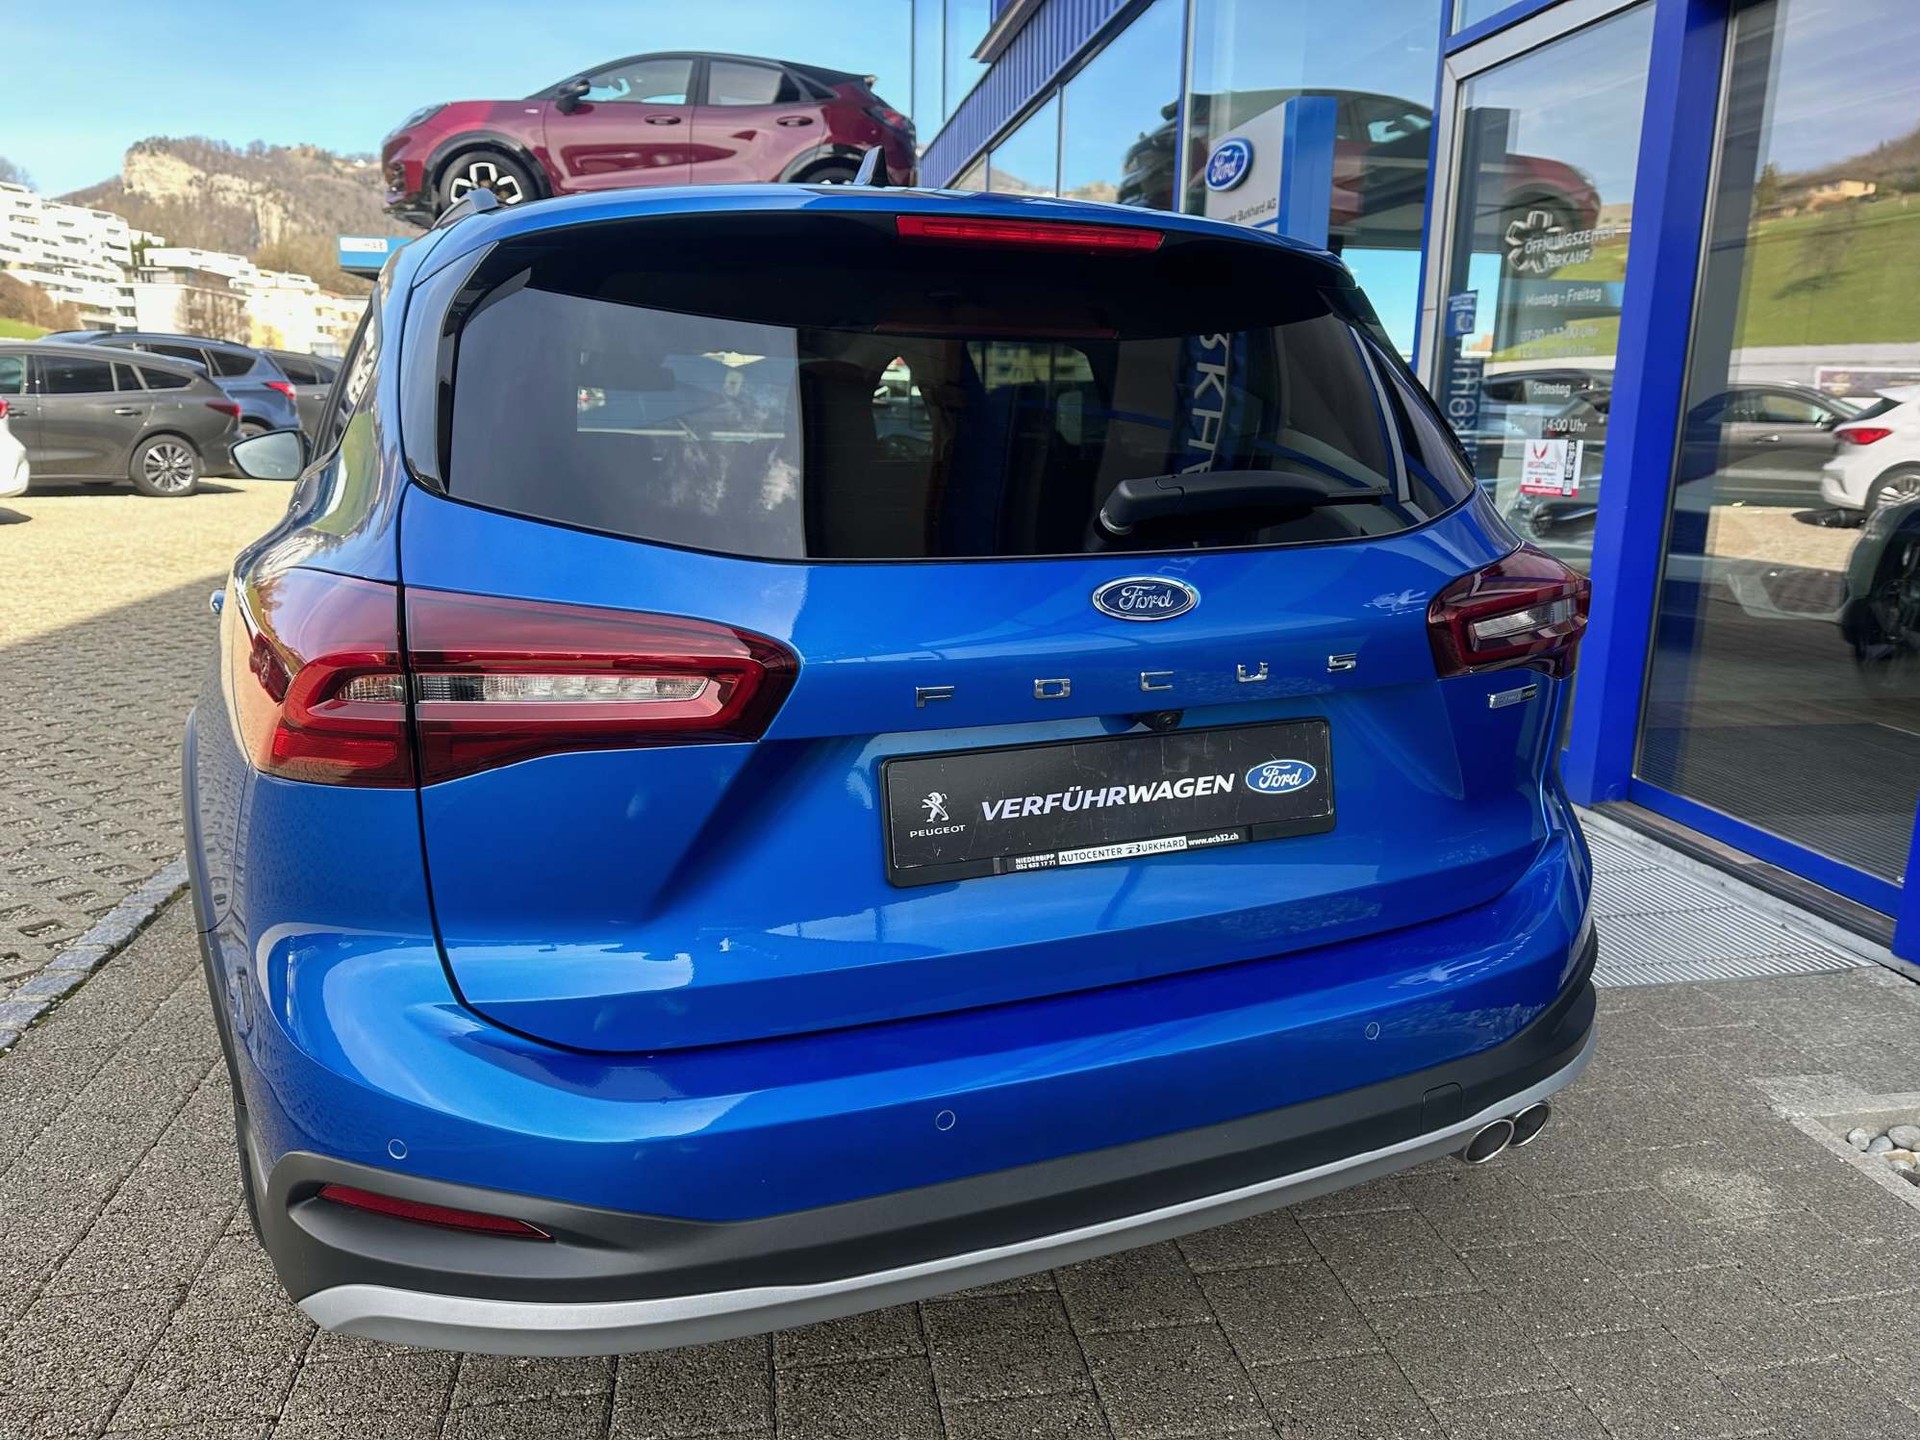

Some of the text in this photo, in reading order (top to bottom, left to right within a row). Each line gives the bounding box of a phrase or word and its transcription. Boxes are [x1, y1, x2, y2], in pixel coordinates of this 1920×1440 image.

[1211, 148, 1240, 183] Ford
[1525, 292, 1559, 307] Montag
[1566, 286, 1601, 303] Freitag
[1533, 383, 1571, 398] Samstag
[1569, 417, 1588, 432] Uhr
[1119, 585, 1174, 610] Ford
[915, 652, 1358, 708] FOCUS
[1259, 764, 1303, 789] Ford
[981, 773, 1236, 821] VERFÜHRWAGEN
[909, 824, 967, 838] PEUGEOT
[1015, 853, 1055, 865] NIEDERBIPP
[1060, 838, 1185, 863] AUTOCENTER BURKHARD
